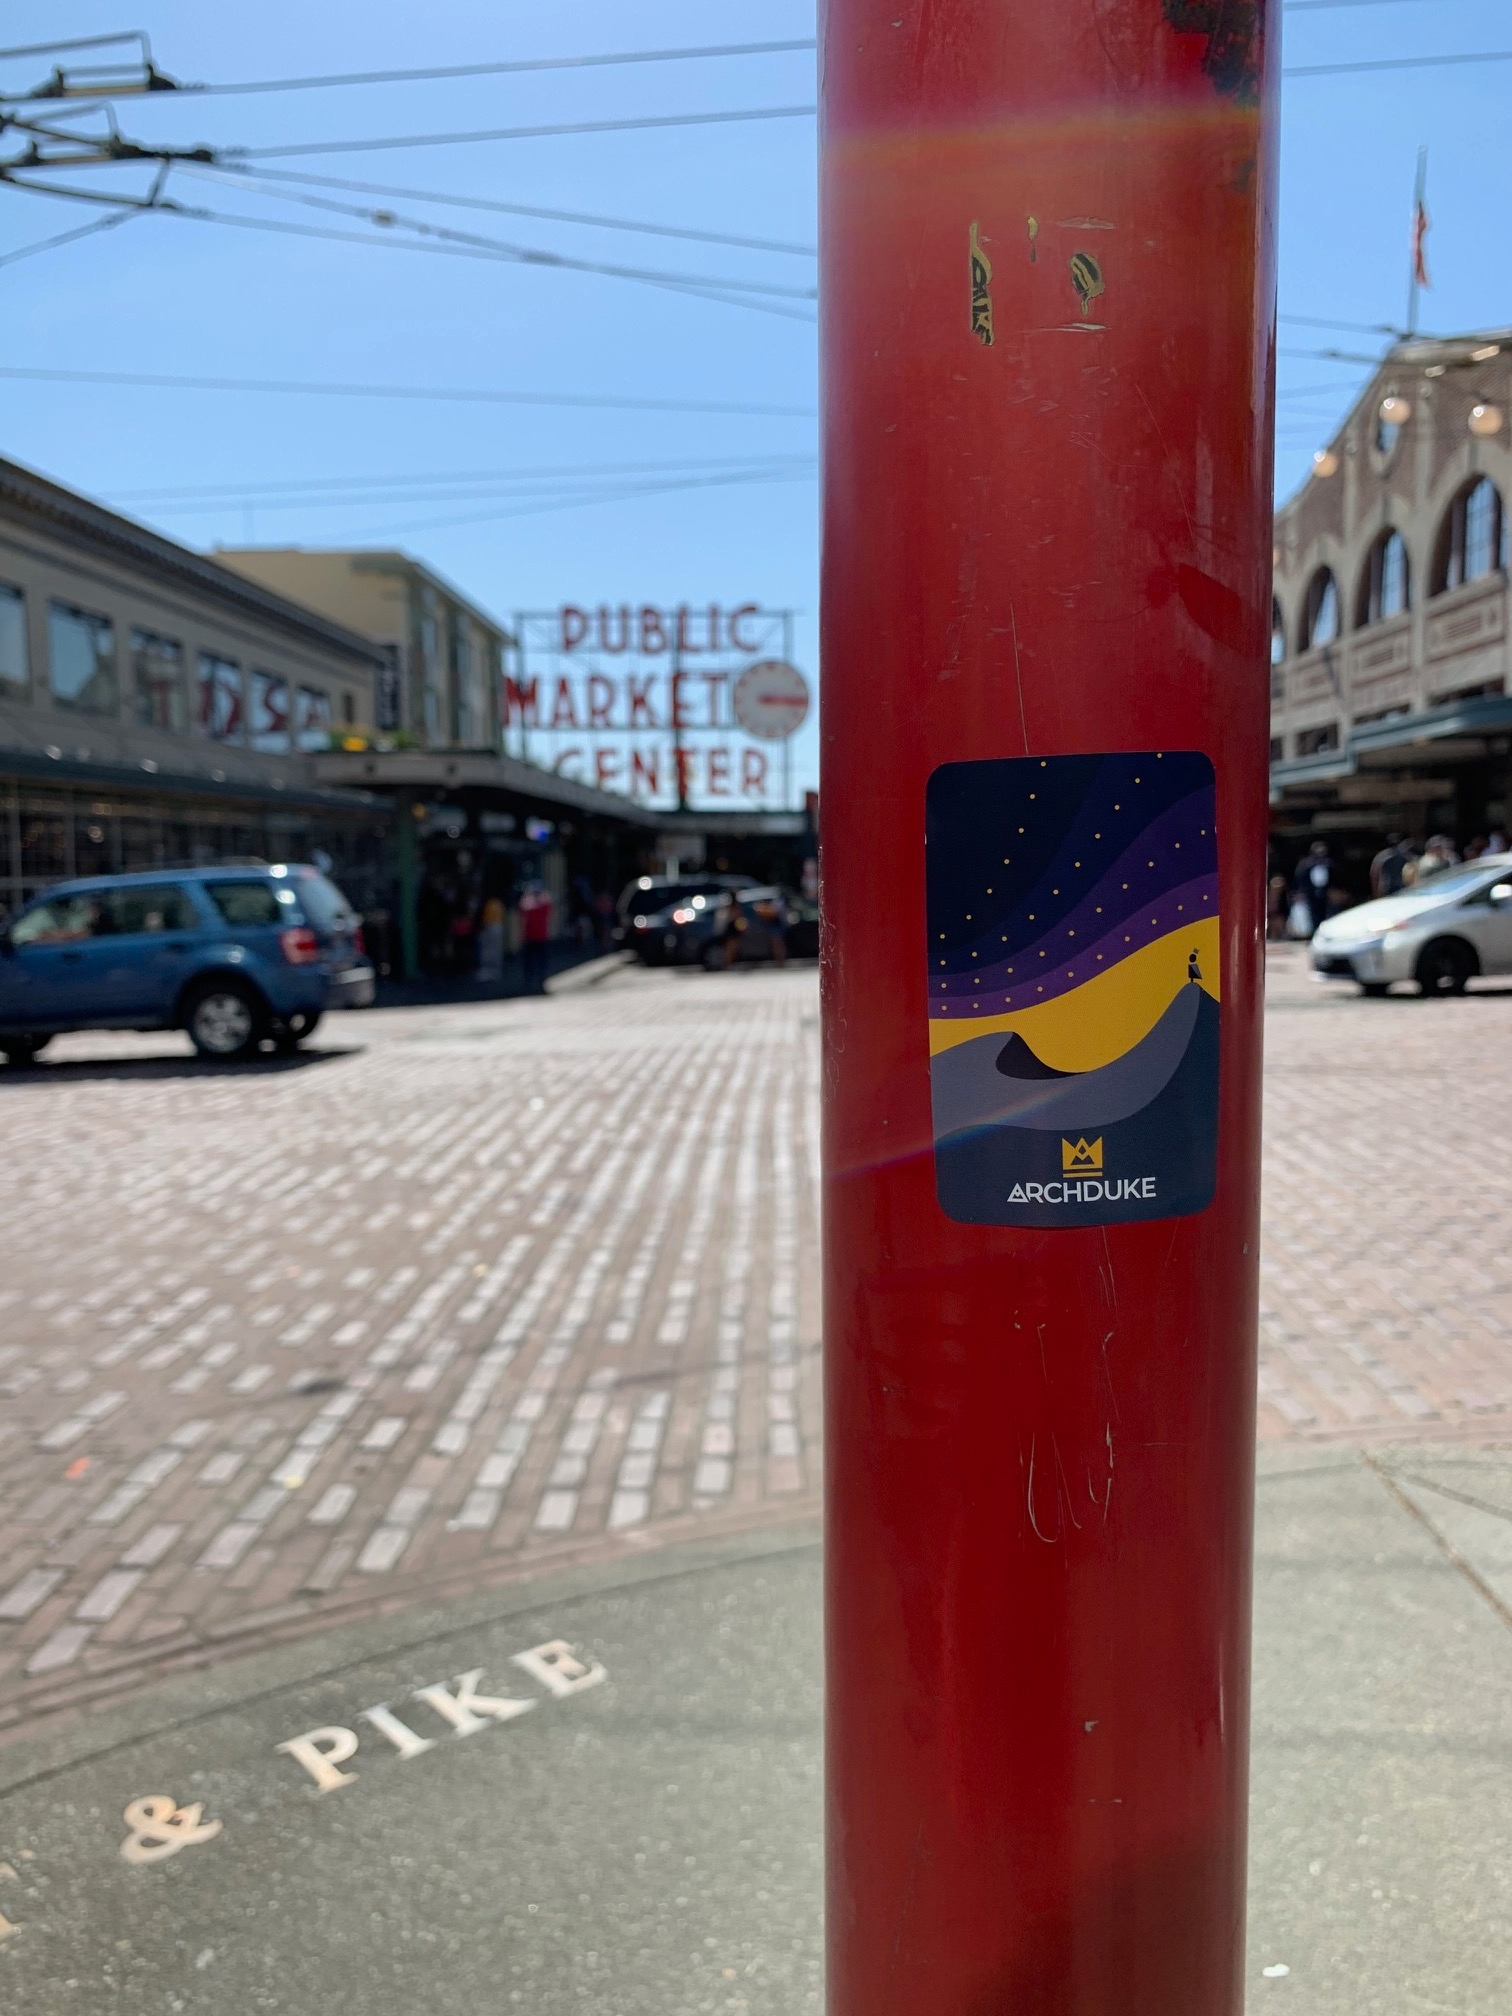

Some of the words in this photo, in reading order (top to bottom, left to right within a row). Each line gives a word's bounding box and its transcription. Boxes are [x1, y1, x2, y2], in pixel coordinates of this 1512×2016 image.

[561, 606, 758, 652] PUBLIC
[502, 672, 729, 728] MARKET
[555, 747, 768, 797] CENTER
[1006, 1176, 1157, 1204] ARCHDUKE
[120, 1794, 223, 1865] &
[275, 1639, 610, 1794] PIKE
